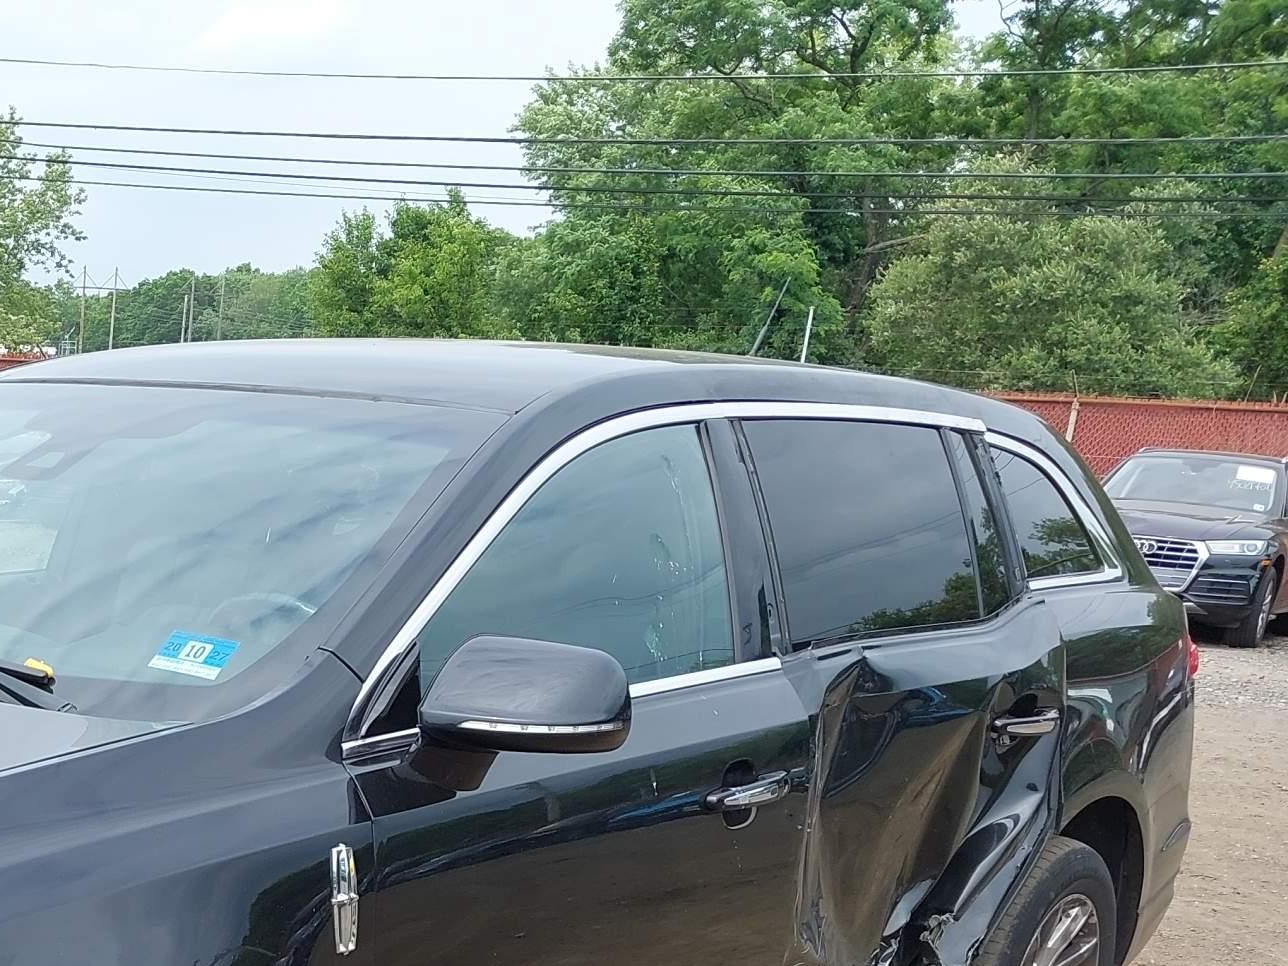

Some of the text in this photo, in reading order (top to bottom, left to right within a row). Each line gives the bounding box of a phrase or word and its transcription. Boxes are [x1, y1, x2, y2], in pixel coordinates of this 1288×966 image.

[165, 641, 230, 661] 20 10 27
